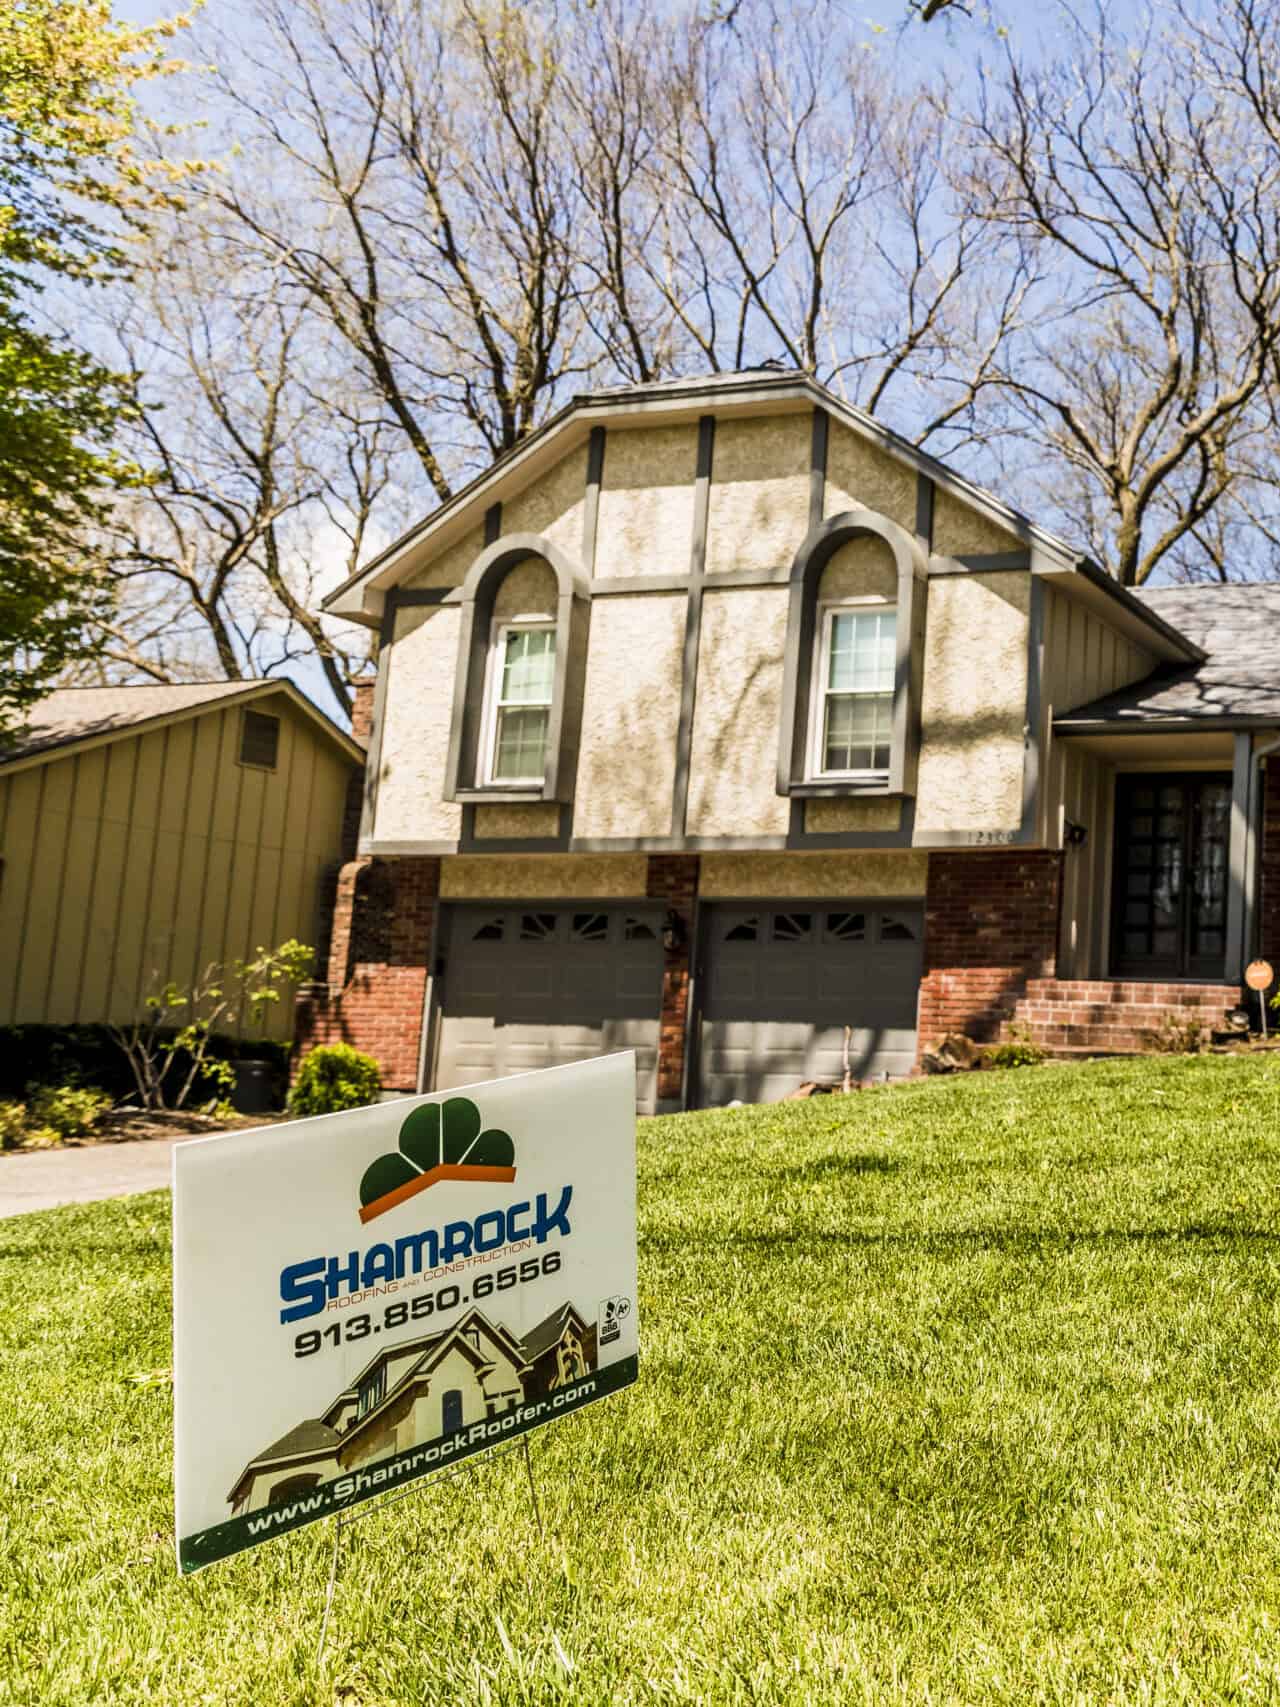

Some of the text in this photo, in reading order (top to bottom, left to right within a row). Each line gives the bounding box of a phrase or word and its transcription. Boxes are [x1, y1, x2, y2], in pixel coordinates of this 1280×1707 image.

[295, 1251, 561, 1358] 913.850.6556
[327, 1281, 399, 1312] ROOFING
[423, 1239, 532, 1283] CONSTRUCTION
[247, 1379, 596, 1535] www.ShamrockRoofer.com
